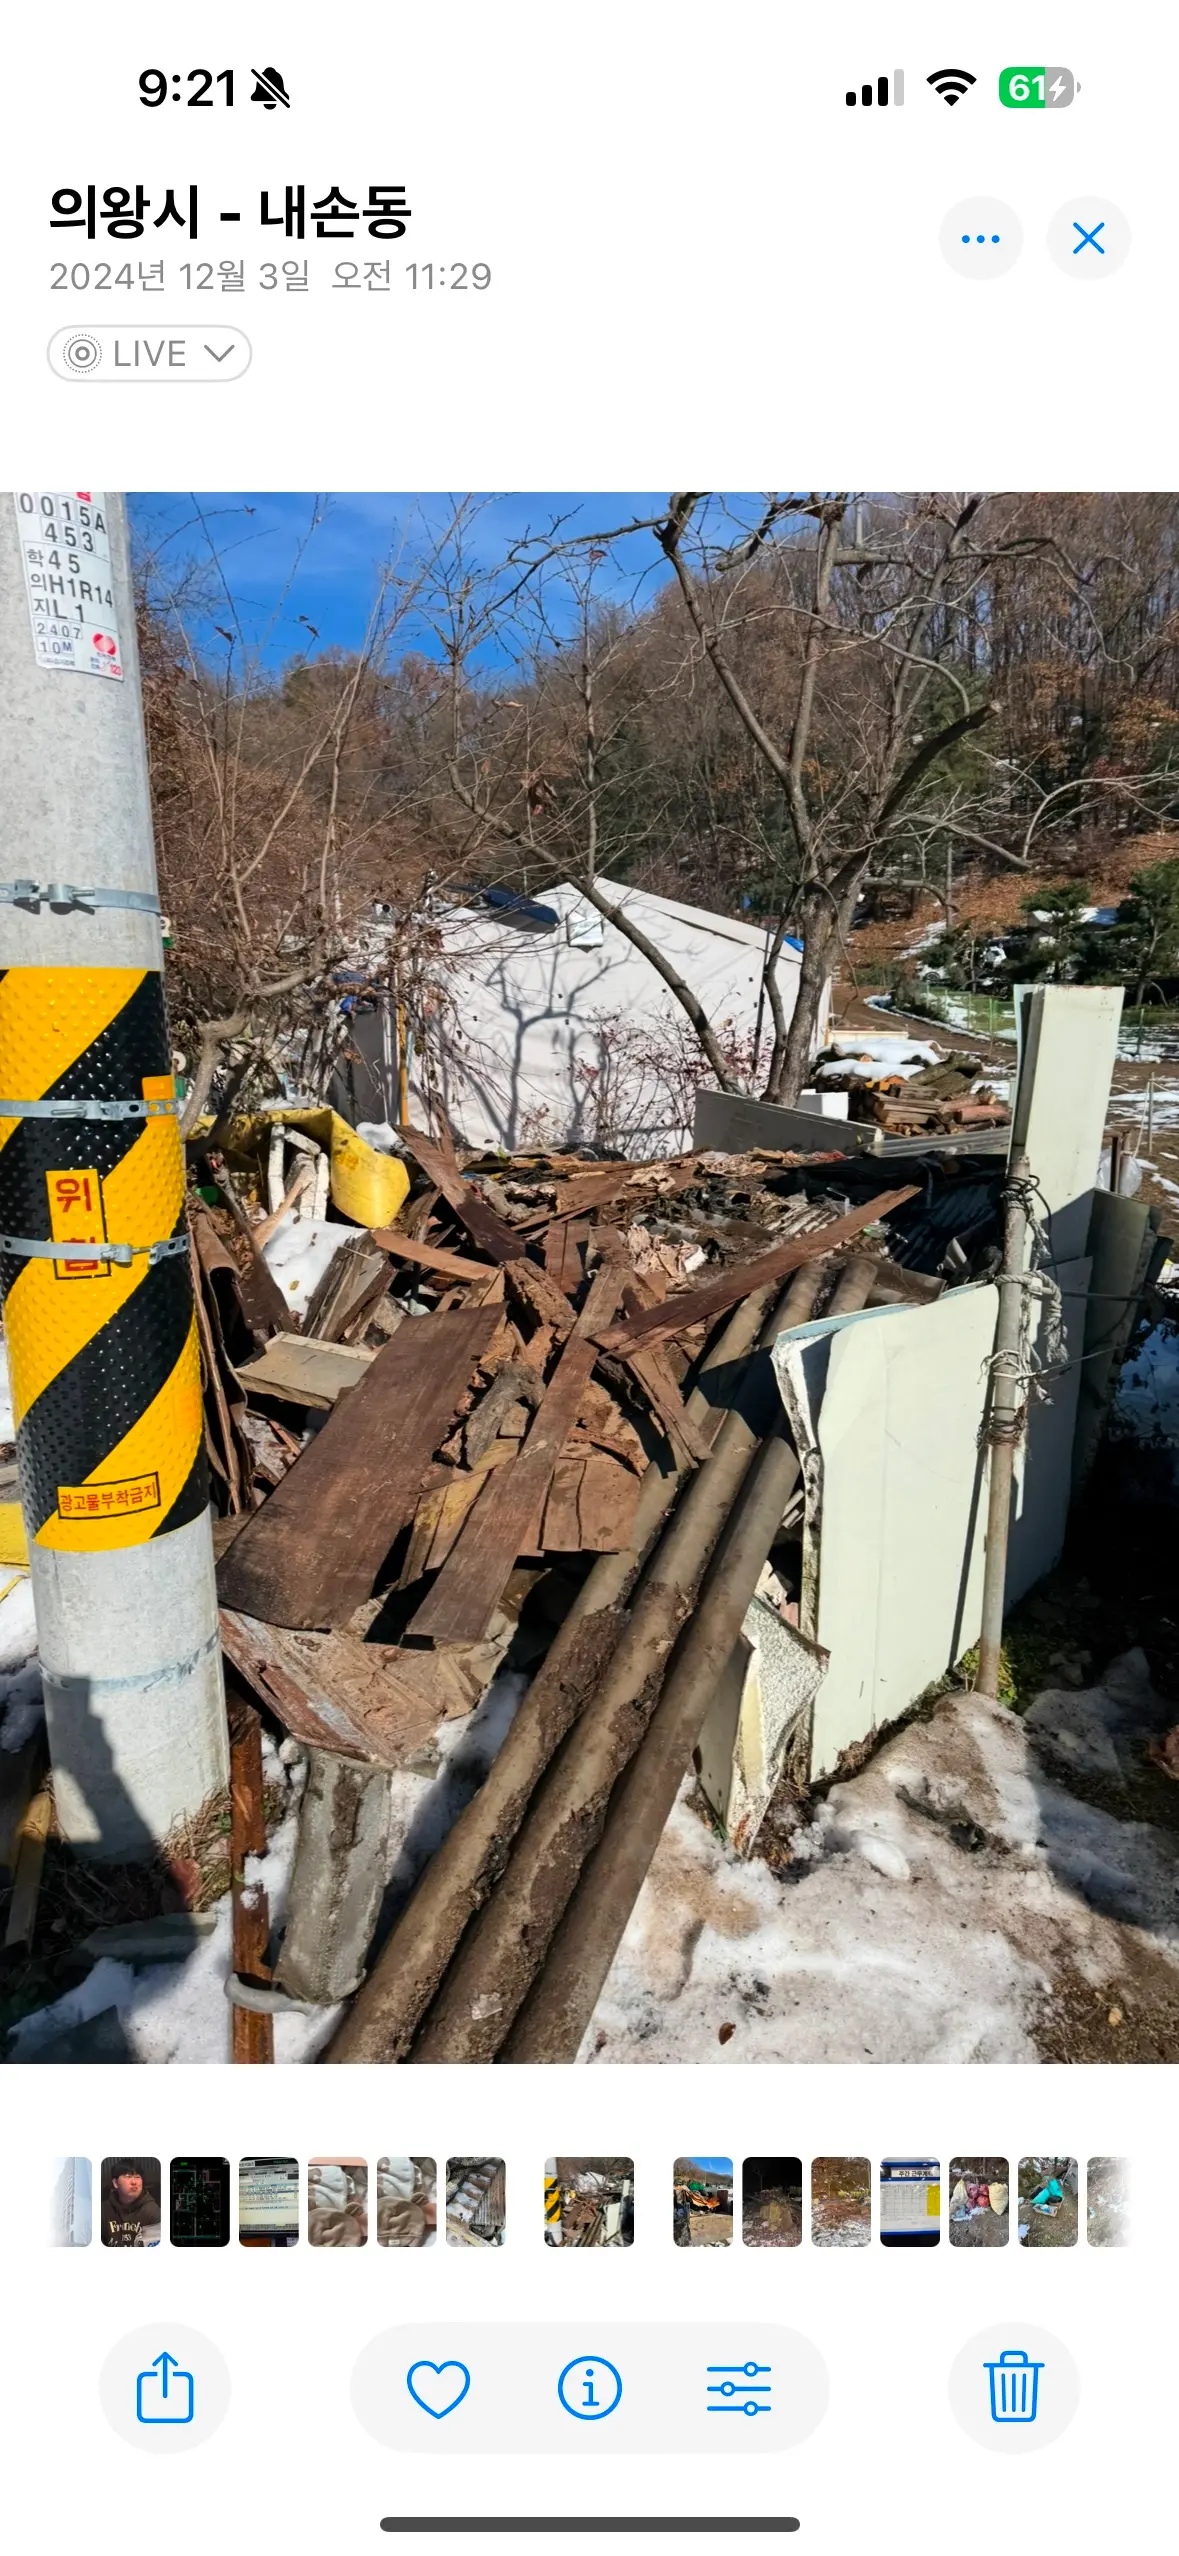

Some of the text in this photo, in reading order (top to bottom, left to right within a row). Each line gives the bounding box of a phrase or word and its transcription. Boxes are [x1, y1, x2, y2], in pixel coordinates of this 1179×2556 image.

[139, 69, 233, 107] 9:21
[1009, 74, 1045, 101] 61
[50, 185, 411, 239] 의왕시 - 내손동
[51, 260, 491, 292] 2024년 12월 3일 오전 11:29
[115, 340, 185, 366] LIVE
[20, 492, 107, 534] 0015A
[45, 522, 95, 552] 453
[37, 622, 81, 640] 2407
[60, 1482, 156, 1512] 광고물부착금지
